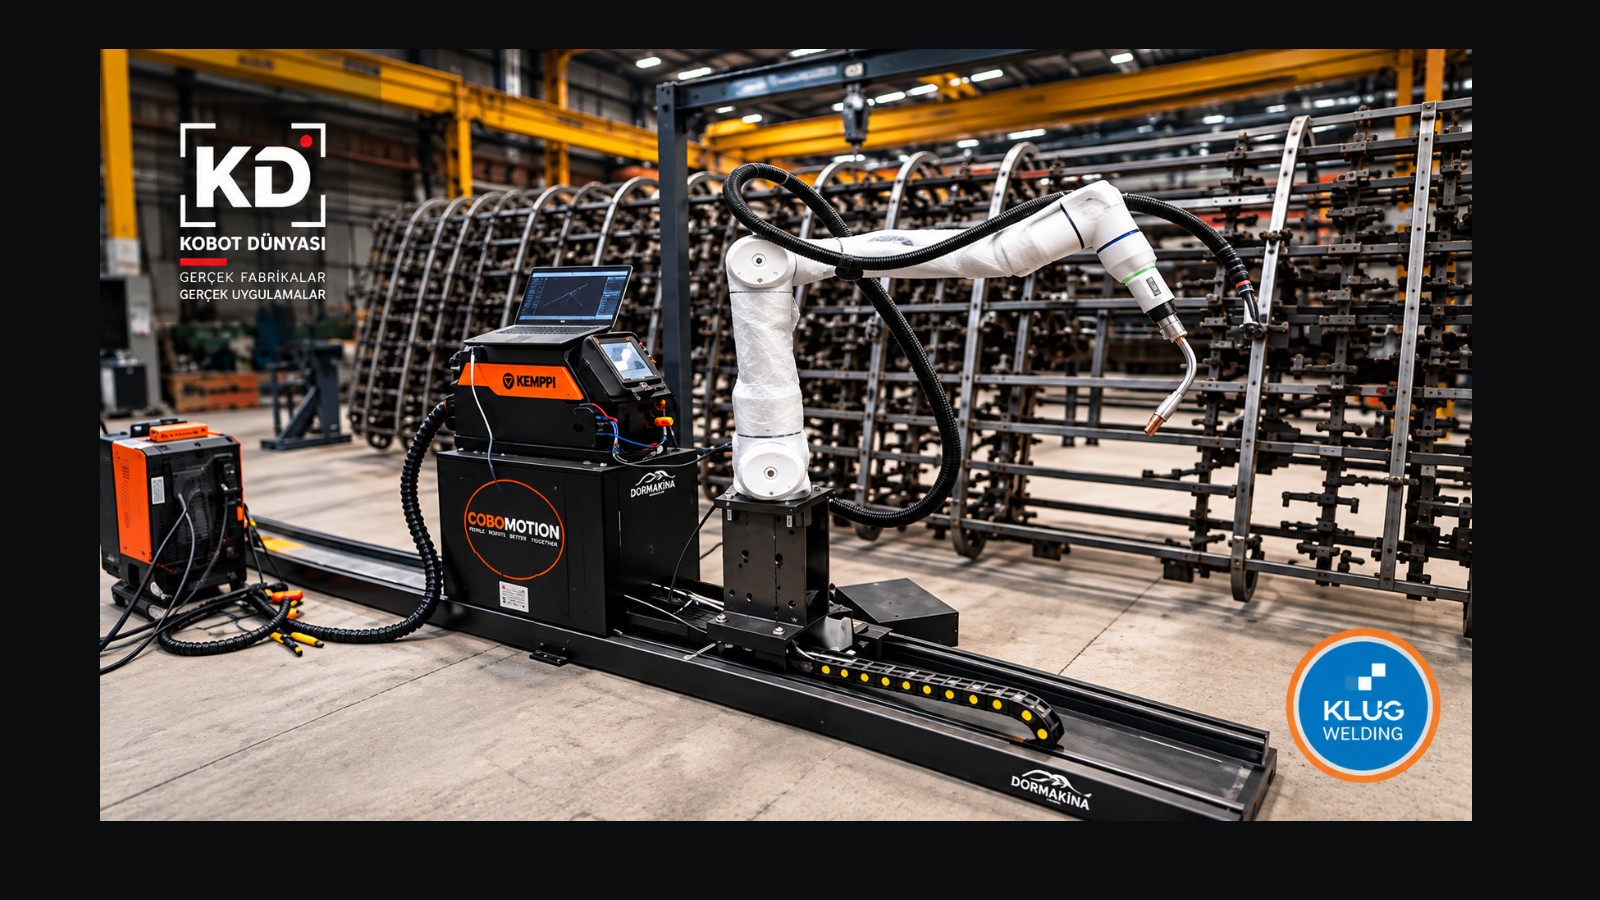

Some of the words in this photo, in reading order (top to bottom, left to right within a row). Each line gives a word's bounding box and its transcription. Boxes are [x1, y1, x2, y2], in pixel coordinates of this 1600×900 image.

[516, 375, 556, 389] KEMPPI
[630, 479, 676, 498] DORMAKİNA
[467, 511, 560, 540] COBOMOTION
[1010, 775, 1090, 811] DORMAKİNA
